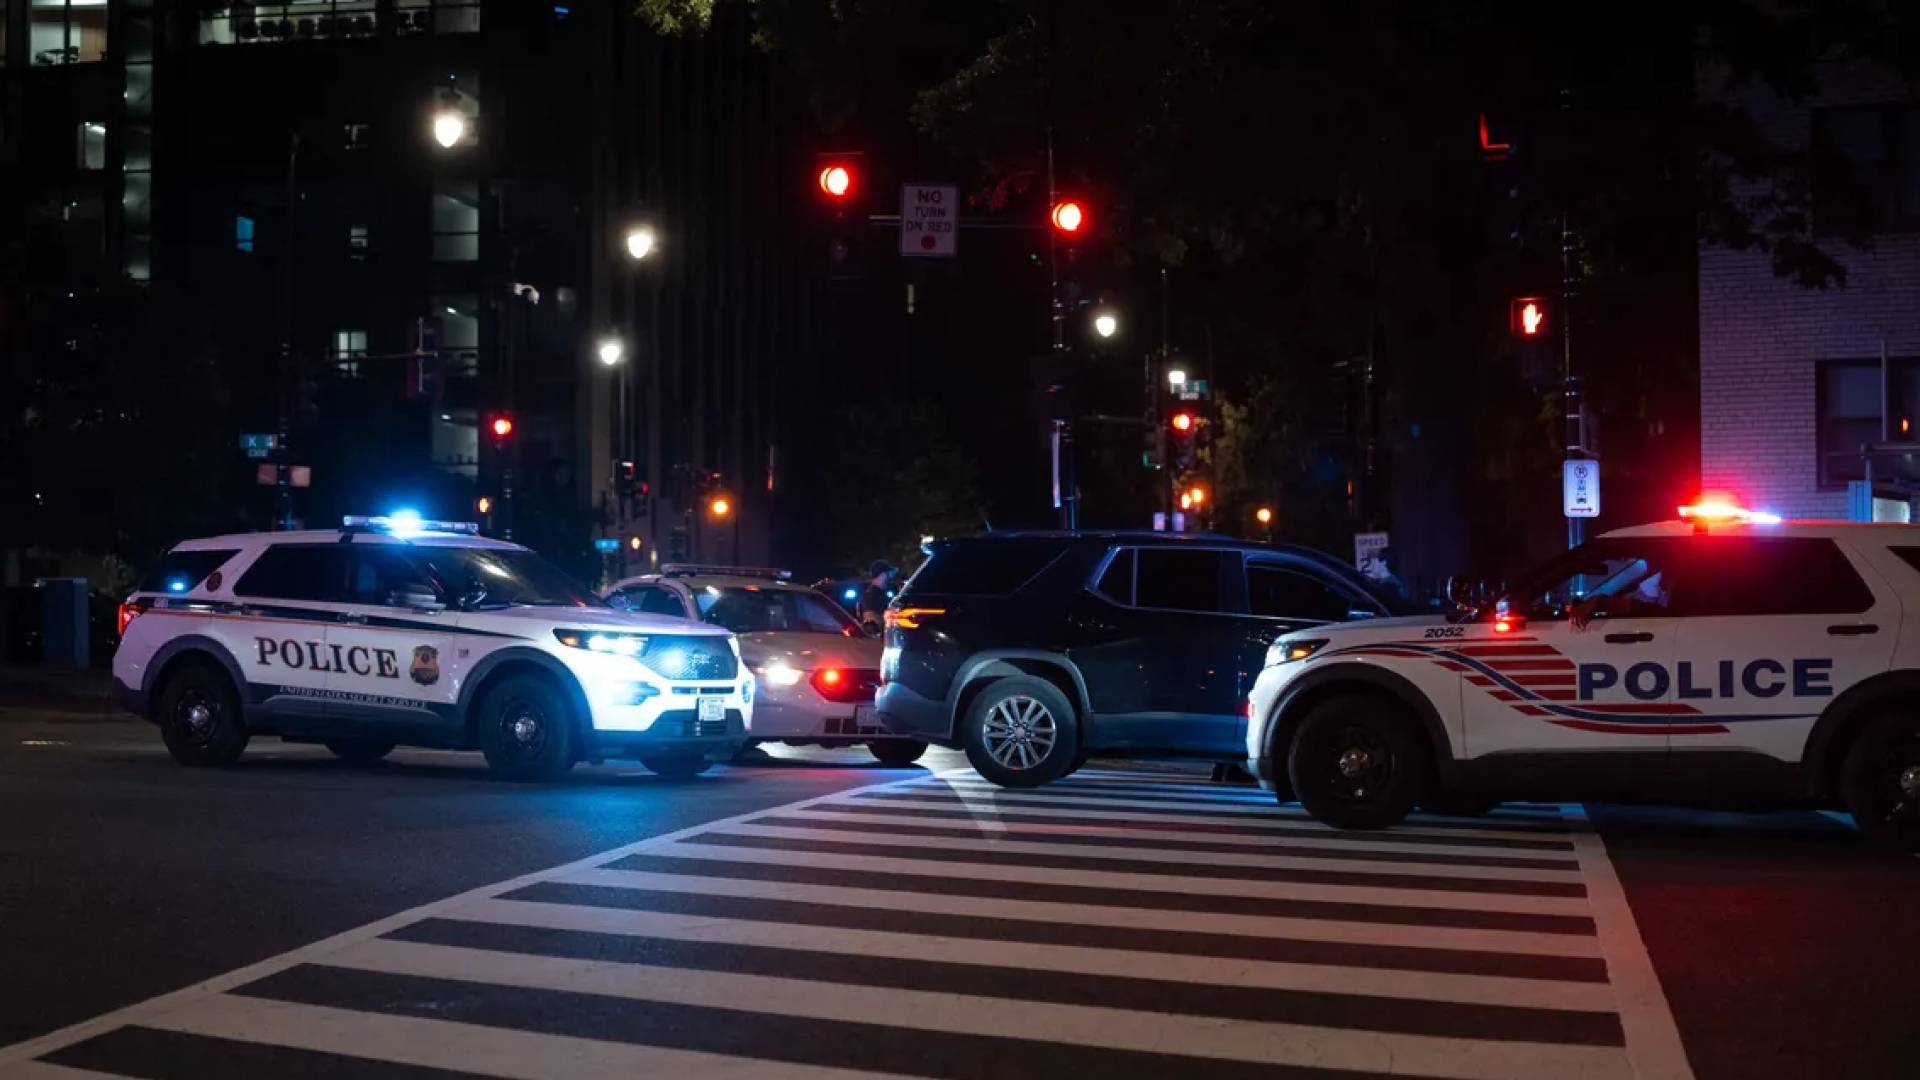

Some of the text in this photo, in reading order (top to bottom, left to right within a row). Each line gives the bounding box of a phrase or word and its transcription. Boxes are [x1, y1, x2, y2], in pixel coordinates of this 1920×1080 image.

[917, 189, 942, 204] NO
[915, 206, 945, 218] TURN
[906, 220, 952, 233] ON RED
[1358, 537, 1385, 546] SPEED
[1424, 626, 1464, 638] 2052
[254, 636, 400, 679] POLICE
[1578, 658, 1834, 701] POLICE
